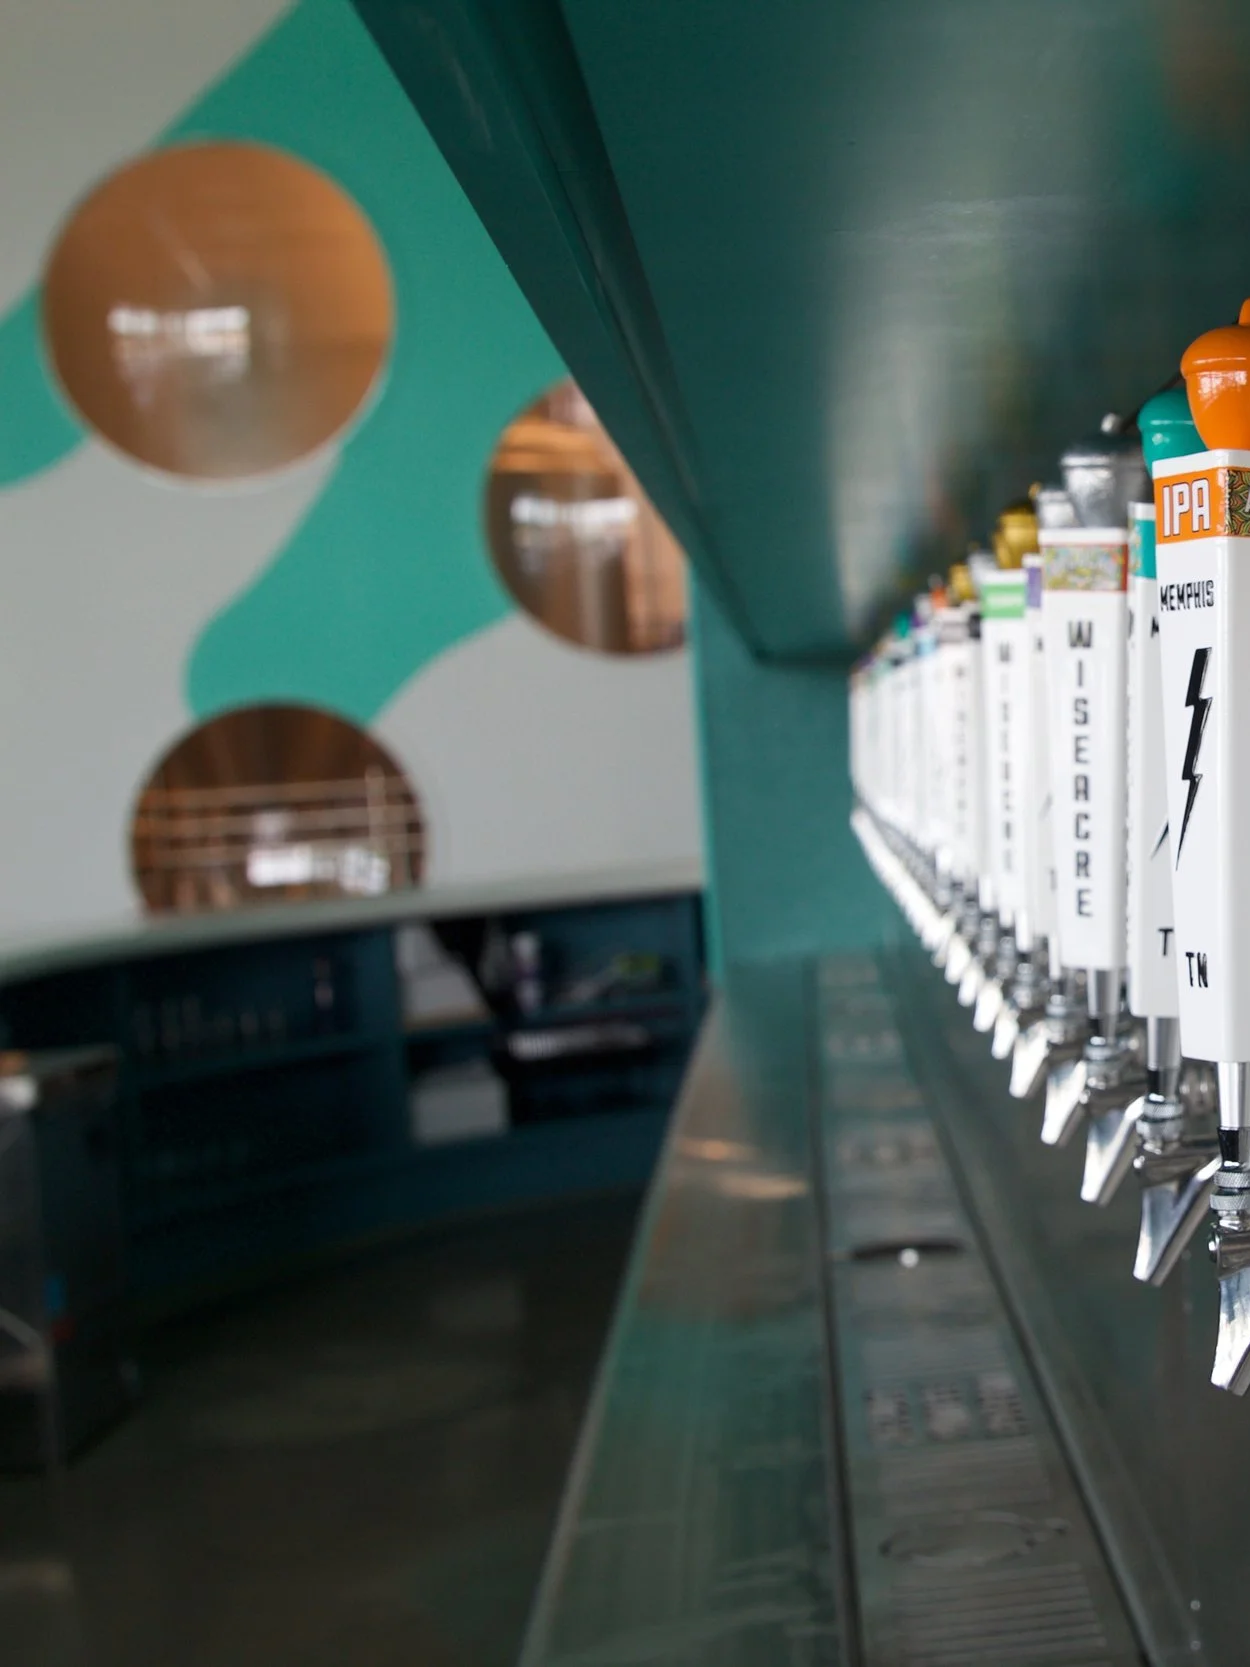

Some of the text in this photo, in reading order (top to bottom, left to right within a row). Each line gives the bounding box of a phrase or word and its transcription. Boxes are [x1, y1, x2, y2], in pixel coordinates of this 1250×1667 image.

[1162, 478, 1211, 538] IPA
[1160, 580, 1215, 612] MEMPHIS
[1068, 620, 1093, 917] WISEACRE
[1185, 951, 1209, 988] TN
